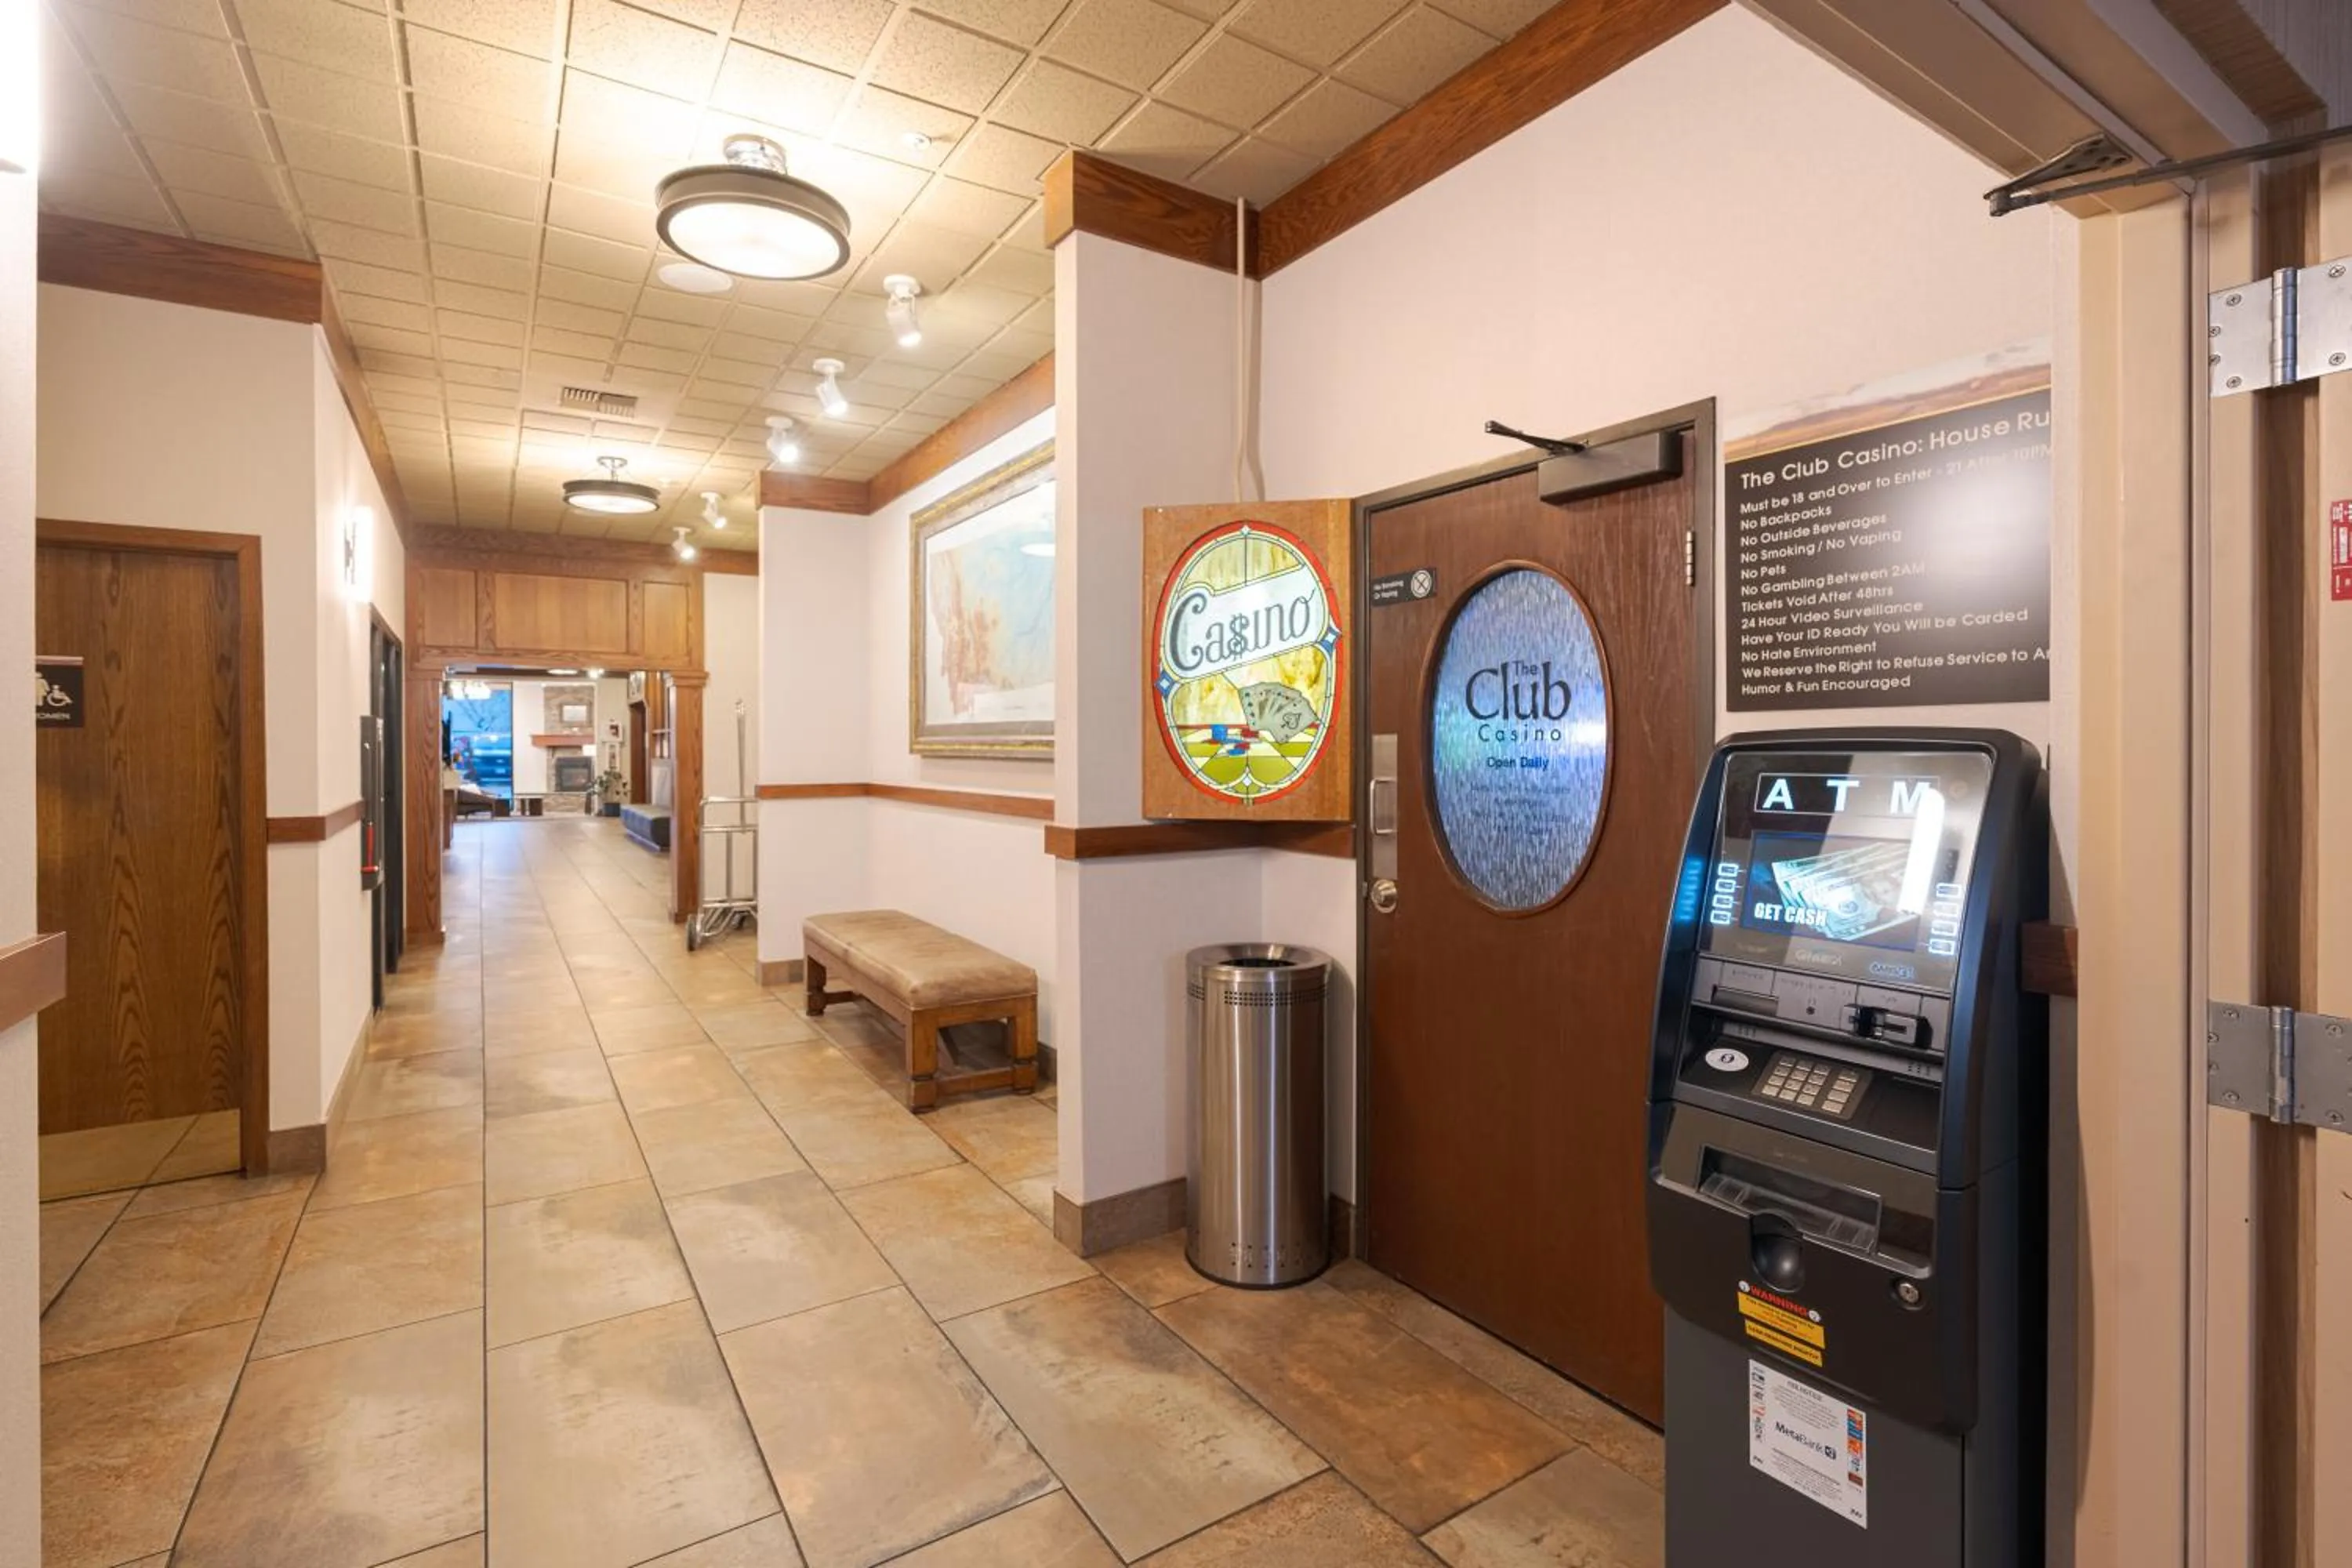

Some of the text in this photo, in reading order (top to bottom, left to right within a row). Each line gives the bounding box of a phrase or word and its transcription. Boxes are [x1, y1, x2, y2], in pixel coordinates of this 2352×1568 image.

[1740, 472, 1775, 489] The
[1782, 458, 1829, 481] Club
[1838, 438, 1923, 469] Casino:
[1929, 420, 2010, 449] House
[1740, 499, 1769, 514] Must
[1772, 497, 1789, 508] be
[1793, 492, 1804, 504] 18
[1809, 485, 1835, 500] and
[1838, 480, 1871, 495] Over
[1877, 477, 1890, 488] to
[1894, 466, 1932, 485] Enter
[1740, 505, 1832, 531] No Backpacks
[1740, 514, 1886, 546] No Outside Beverages
[1740, 552, 1758, 563] No
[1761, 543, 1815, 561] Smoking
[1826, 539, 1845, 550] No
[1850, 530, 1902, 547] Vaping
[1740, 564, 1786, 579] No Pets
[1741, 584, 1758, 596] No
[1761, 576, 1824, 593] Gambling
[1827, 568, 1888, 586] Between
[1742, 586, 1893, 612] Tickets Void After 48hrs
[1741, 601, 1923, 630] 24 Hour Video Surveillance
[1741, 608, 2028, 646] Have Your ID Ready You Will be Carded
[1741, 641, 1876, 662] No Hate Environment
[1742, 666, 1762, 678] We
[1763, 665, 1813, 677] Reserve
[1815, 662, 1836, 673] the
[1838, 659, 1872, 674] Right
[1877, 659, 1891, 670] to
[1894, 656, 1944, 669] Refuse
[1947, 651, 2007, 666] Service
[2012, 649, 2028, 662] to
[1512, 661, 1538, 676] The
[1465, 662, 1572, 720] Club
[1741, 675, 1911, 696] Humor & Fun Encouraged
[1478, 724, 1561, 742] Casino
[1486, 757, 1549, 771] Open Daily
[1754, 902, 1828, 926] GET CASH
